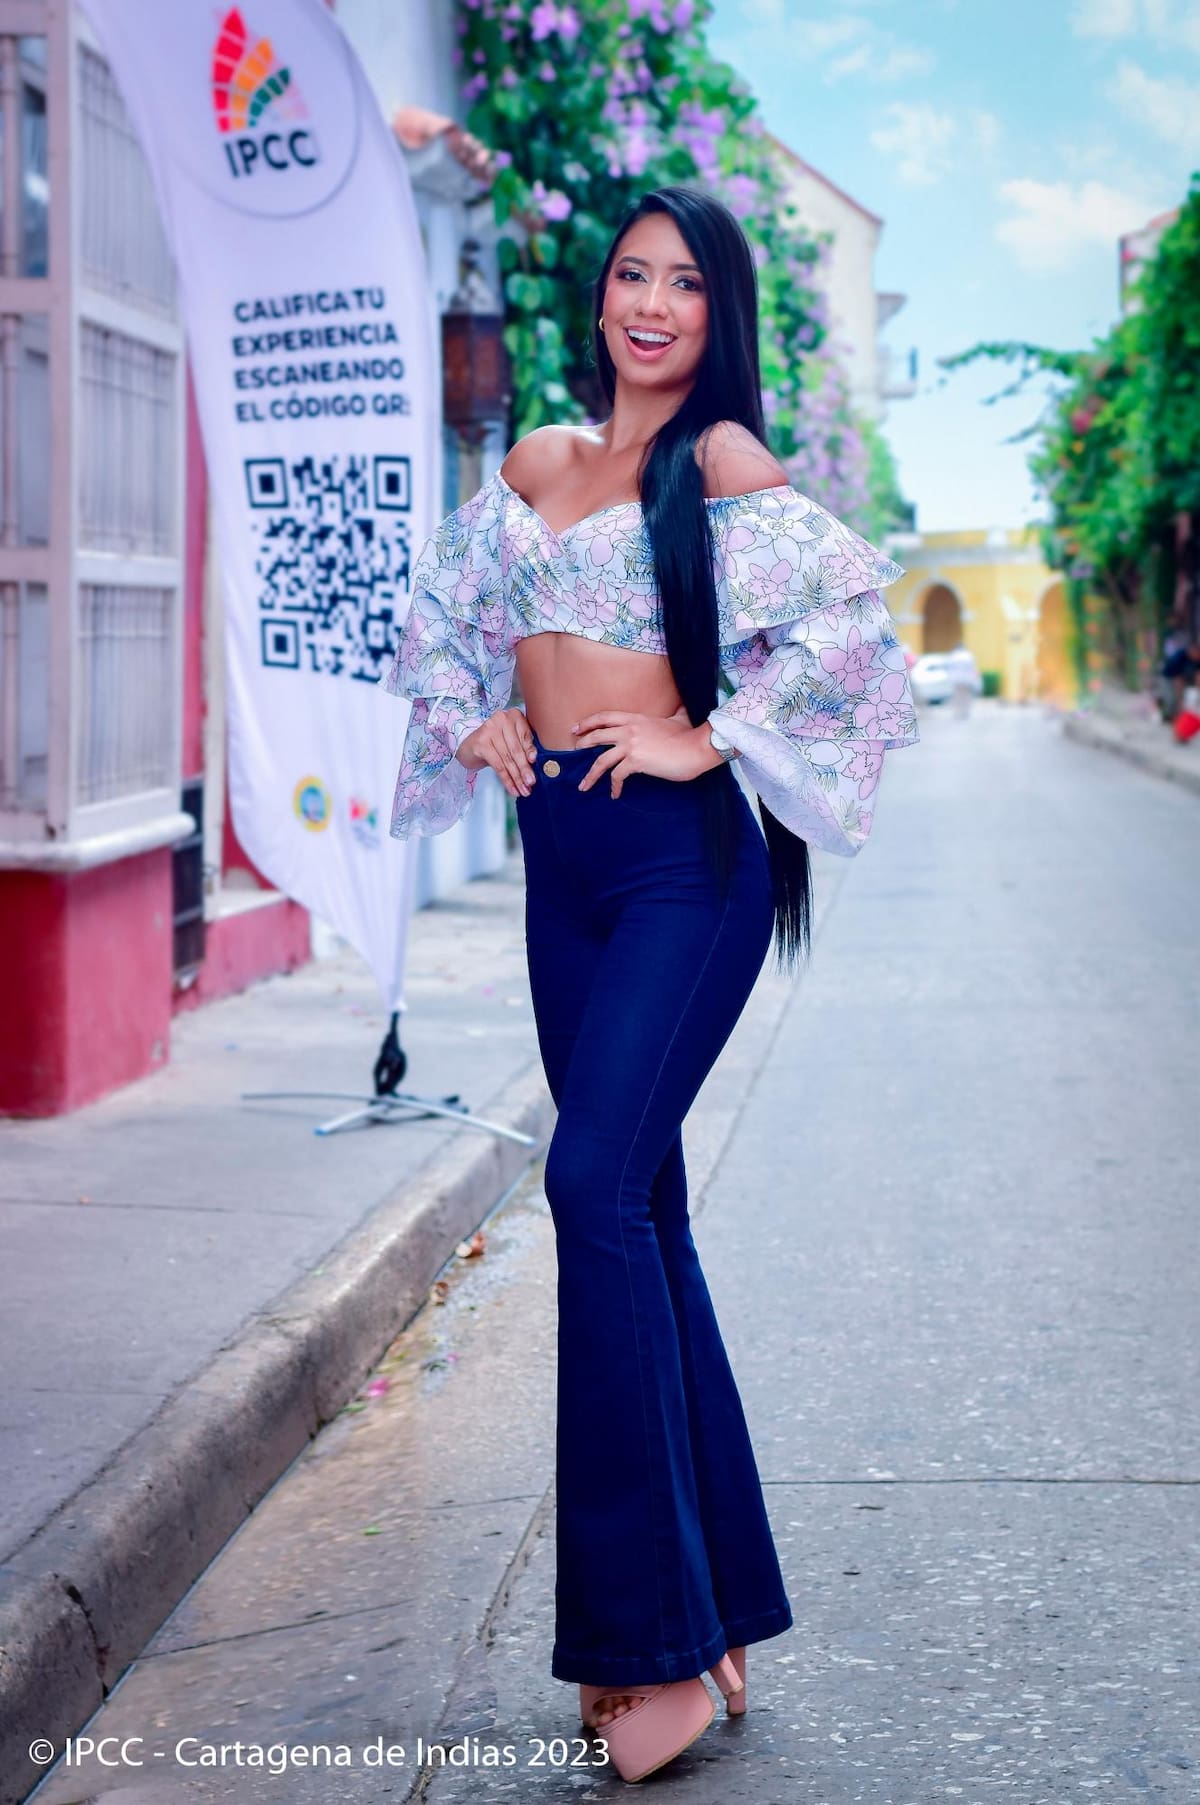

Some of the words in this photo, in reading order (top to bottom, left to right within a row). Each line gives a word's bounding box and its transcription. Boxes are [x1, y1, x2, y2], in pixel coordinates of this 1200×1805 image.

[224, 130, 317, 178] IPCC
[234, 292, 348, 324] CALIFICA
[353, 287, 385, 311] TU
[232, 323, 398, 357] EXPERIENCIA
[234, 358, 405, 390] ESCANEANDO
[236, 403, 265, 422] EL
[269, 391, 367, 420] CÓDIGO
